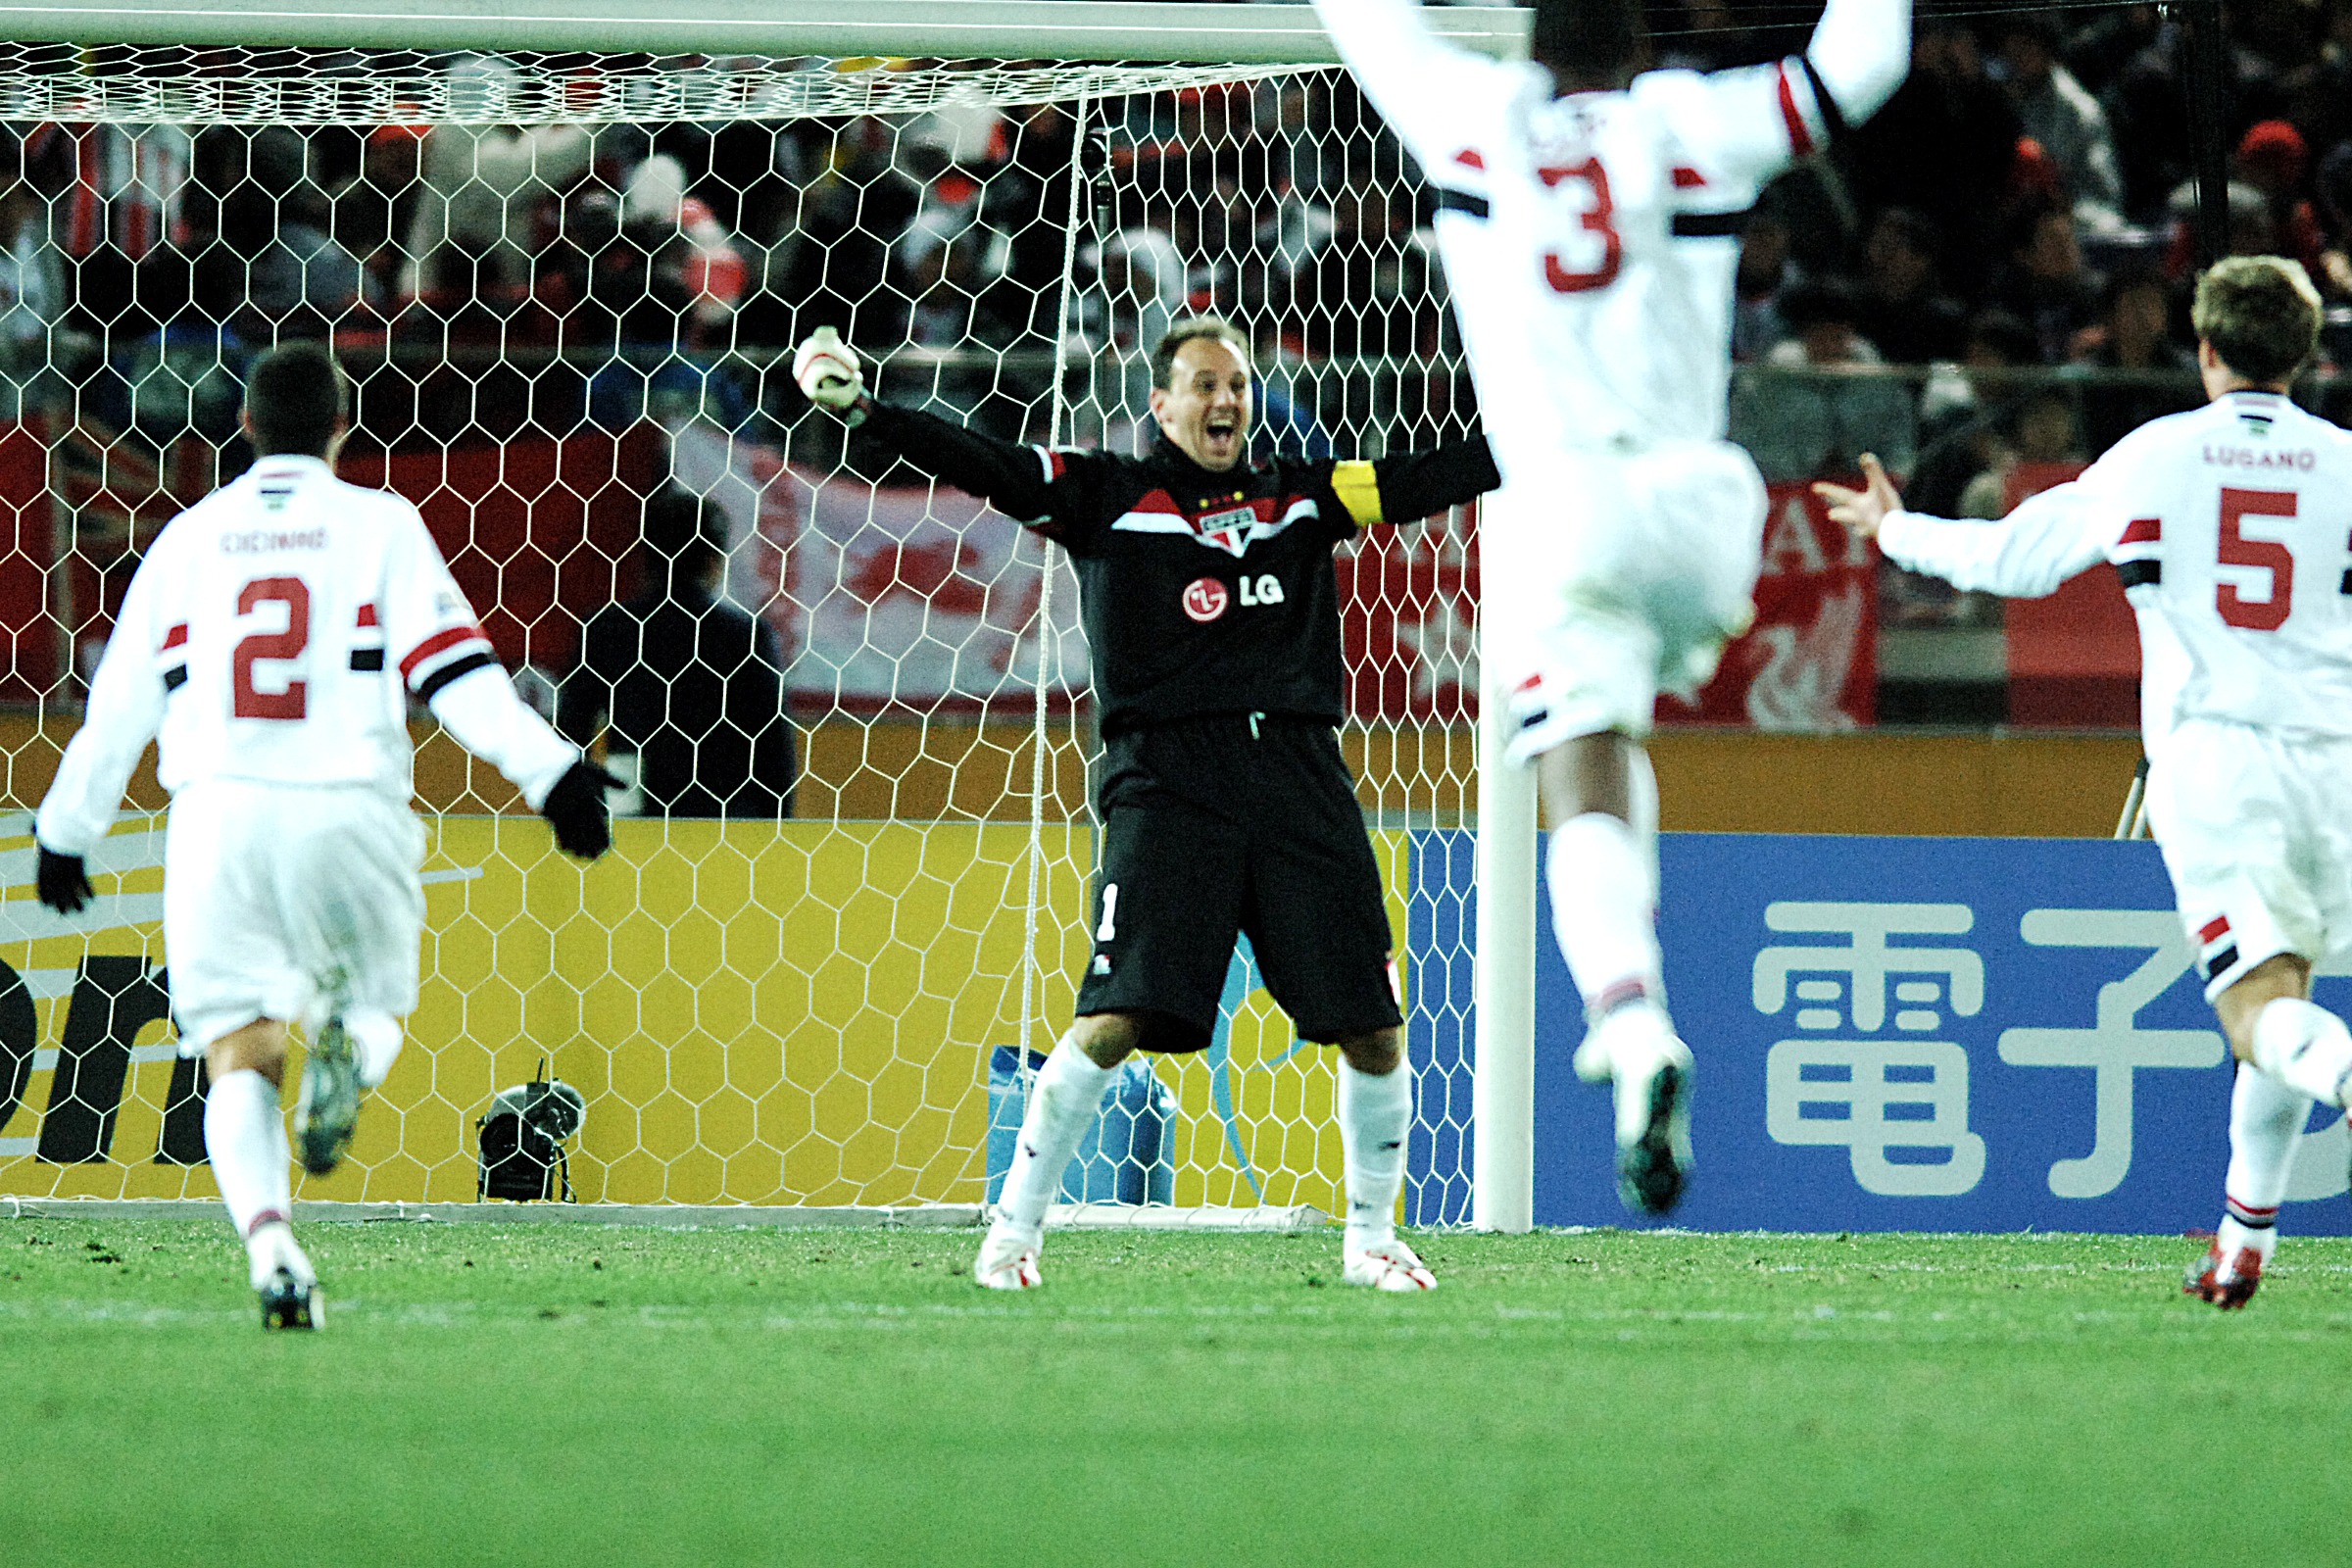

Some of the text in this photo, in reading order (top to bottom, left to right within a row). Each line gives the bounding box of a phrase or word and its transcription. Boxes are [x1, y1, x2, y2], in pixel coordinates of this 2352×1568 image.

[1538, 157, 1622, 293] 3
[2202, 444, 2317, 472] LUGANO
[1239, 574, 1285, 606] LG
[2216, 488, 2297, 631] 5
[233, 577, 310, 718] 2
[1097, 883, 1119, 941] 1
[1752, 901, 2352, 1203] 電子
